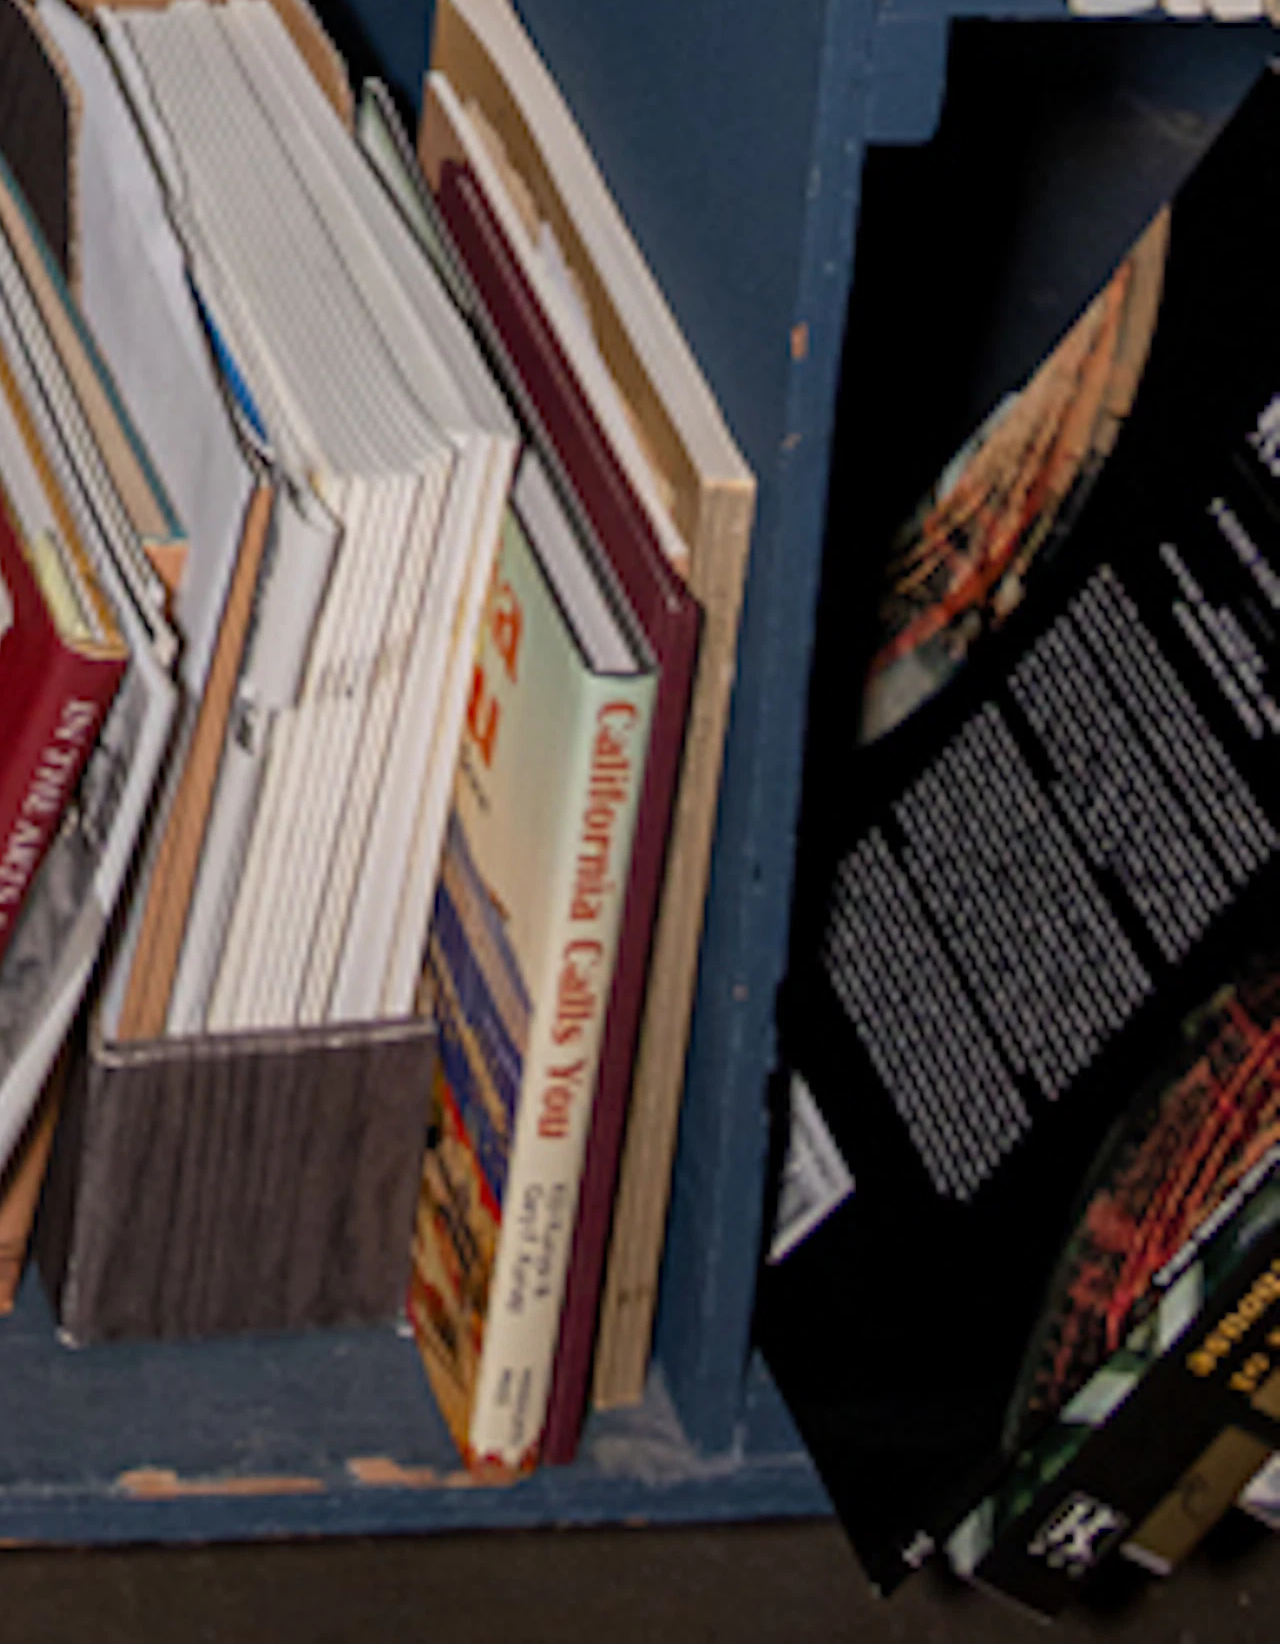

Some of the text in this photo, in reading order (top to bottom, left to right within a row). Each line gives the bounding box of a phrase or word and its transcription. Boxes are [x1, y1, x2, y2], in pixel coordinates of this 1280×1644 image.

[23, 740, 77, 814] THE
[565, 698, 641, 926] California
[550, 939, 607, 1047] Calls
[535, 1061, 589, 1143] You
